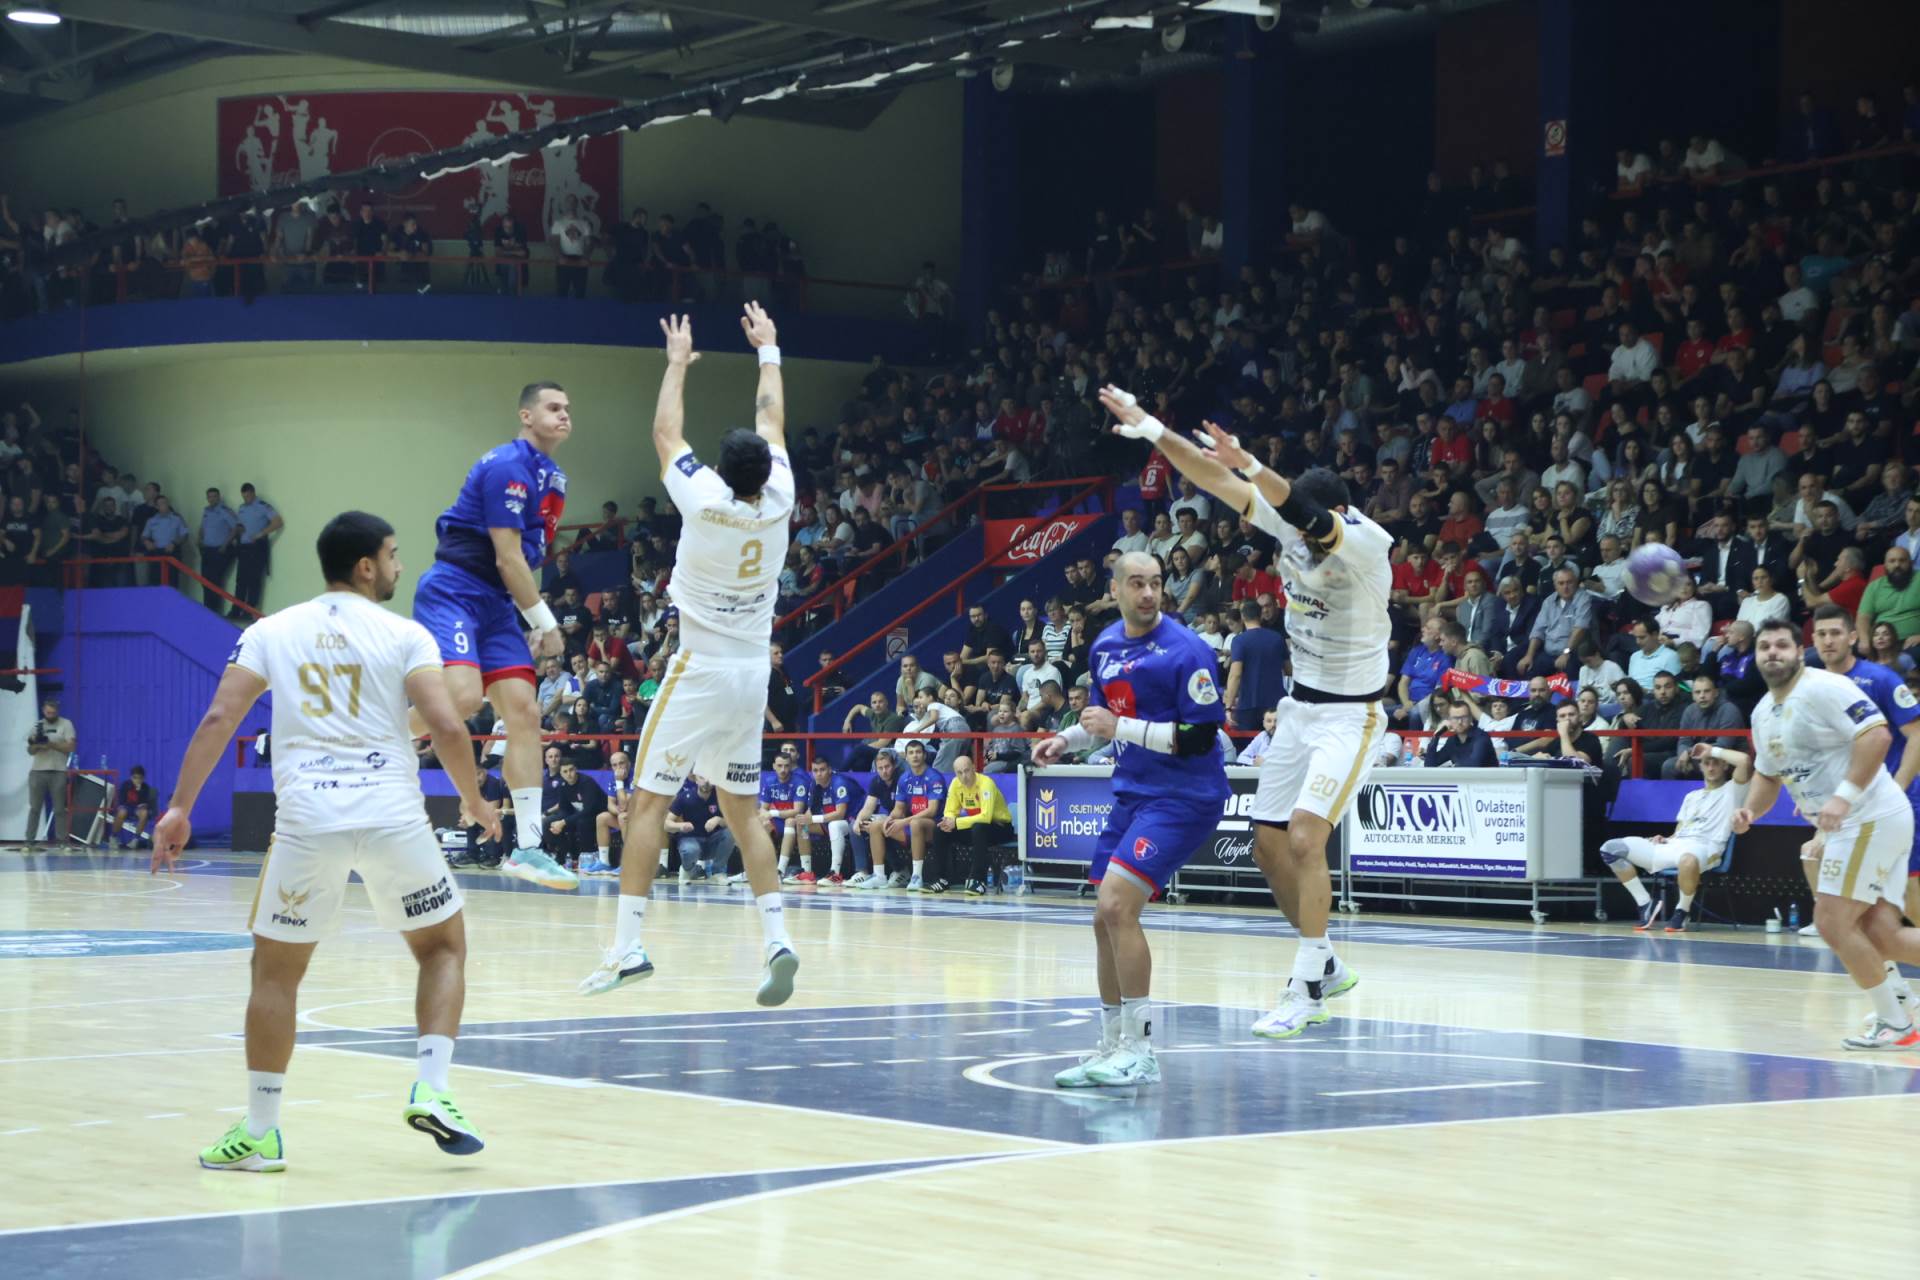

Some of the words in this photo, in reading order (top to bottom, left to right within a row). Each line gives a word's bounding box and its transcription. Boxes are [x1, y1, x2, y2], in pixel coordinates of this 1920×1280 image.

[537, 468, 547, 491] 9
[1145, 468, 1157, 487] 6
[737, 539, 762, 579] 2
[453, 631, 469, 655] 9
[1096, 651, 1110, 679] 7
[297, 662, 363, 718] 97
[1310, 774, 1338, 797] 20
[1069, 803, 1093, 815] OSJETI
[1475, 799, 1525, 814] Ovlašteni
[1484, 815, 1526, 827] uvoznik
[1035, 831, 1058, 848] bet
[1363, 833, 1423, 844] AUTOCENTAR
[1426, 835, 1466, 845] MERKUR
[1495, 830, 1525, 845] guma
[1822, 858, 1843, 877] 55
[401, 887, 431, 903] FITNESS
[271, 913, 308, 927] FENIX
